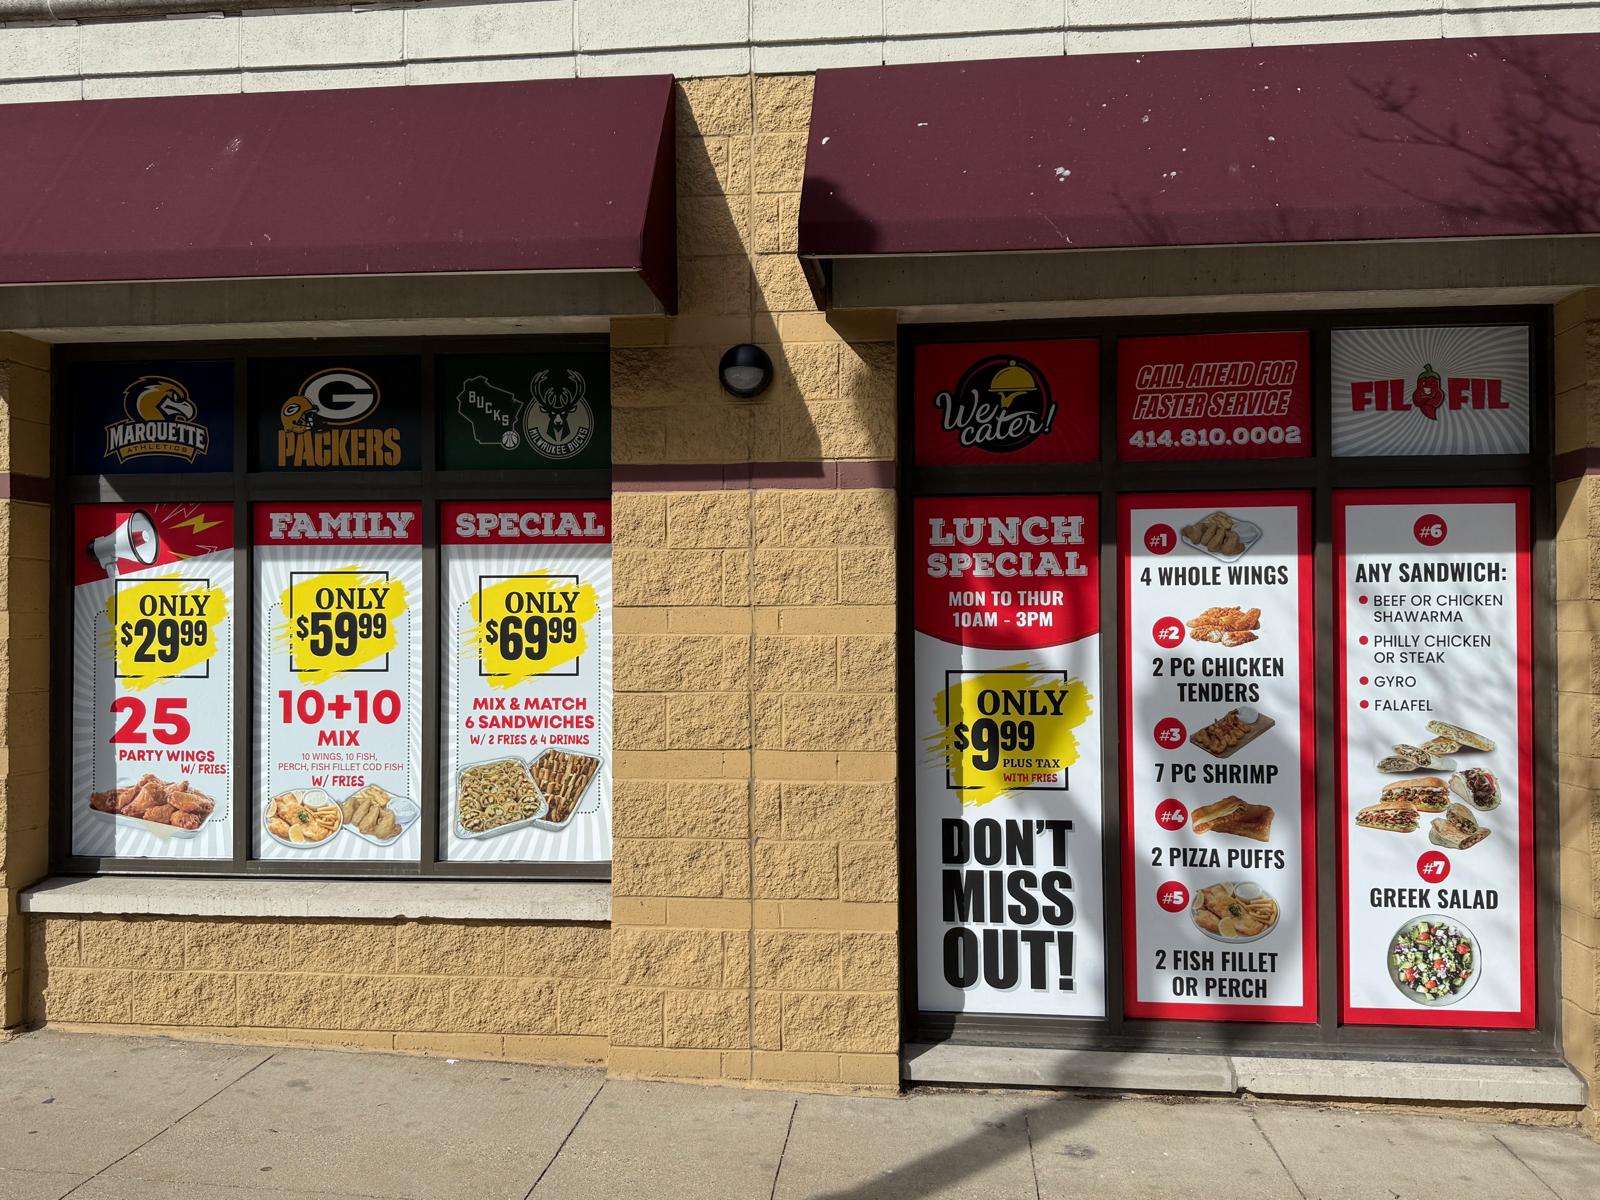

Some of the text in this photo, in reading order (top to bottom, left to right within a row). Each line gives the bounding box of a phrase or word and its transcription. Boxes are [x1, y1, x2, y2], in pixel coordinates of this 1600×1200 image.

[1136, 360, 1297, 390] CALL AHEAD FOR
[1351, 378, 1509, 411] FIL FIL
[469, 391, 509, 426] BUCKS
[936, 389, 999, 430] We
[1133, 390, 1292, 420] FASTER SERVICE
[961, 404, 1056, 445] cater!
[110, 422, 207, 450] MARQUETTE
[528, 428, 588, 455] MILWAUKEE BUCKS
[1129, 426, 1301, 448] 414.810.0002
[127, 443, 187, 453] ATHLETICS
[278, 428, 401, 466] PACKERS
[270, 512, 604, 540] FAMILY SPECIAL
[929, 516, 1084, 546] LUNCH
[1420, 524, 1442, 538] #6
[1150, 533, 1167, 547] #1
[927, 552, 1088, 578] SPECIAL
[1355, 563, 1506, 582] ANY SANDWICH:
[1140, 566, 1288, 586] 4 WHOLE WINGS
[140, 595, 210, 616] ONLY
[316, 588, 390, 609] ONLY
[505, 592, 580, 613] ONLY
[949, 591, 1063, 607] MON TO THUR
[1374, 595, 1503, 606] BEEF OR CHICKEN
[953, 612, 997, 627] 10AM
[1016, 612, 1052, 626] 3PM
[1374, 611, 1463, 622] SHAWARMA
[1158, 626, 1179, 639] #2
[1374, 635, 1491, 648] PHILLY CHICKEN
[1374, 651, 1445, 663] OR STEAK
[1152, 658, 1284, 677] 2 PC CHICKEN
[1374, 676, 1416, 687] GYRO
[1177, 683, 1260, 702] TENDERS
[279, 690, 401, 724] 10+10
[473, 697, 586, 710] MIX & MATCH
[977, 690, 1068, 716] ONLY
[1375, 700, 1433, 711] FALAFEL
[109, 696, 191, 745] 25
[465, 715, 594, 729] 6 SANDWICHES
[318, 730, 360, 746] MIX
[470, 734, 589, 745] W/ 2 FRIES & 4 DRINKS
[1160, 728, 1181, 742] #3
[120, 750, 215, 762] PARTY WINGS
[312, 753, 343, 761] WINGS,
[357, 753, 377, 761] FISH,
[1003, 759, 1060, 768] PLUS TAX
[181, 764, 226, 774] W/ FRIES
[278, 763, 308, 771] PERCH,
[1155, 763, 1278, 784] 7 PC SHRIMP
[312, 775, 365, 787] W/ FRIES
[1003, 773, 1057, 783] WITH FRIES
[1161, 810, 1184, 823] #4
[942, 818, 1074, 867] DON'T
[1151, 847, 1285, 869] 2 PIZZA PUFFS
[1423, 861, 1445, 875] #7
[942, 870, 1075, 926] MISS
[1163, 891, 1183, 905] #5
[1370, 888, 1498, 909] GREEK SALAD
[943, 927, 1075, 991] OUT!
[1156, 950, 1278, 973] 2 FISH FILLET
[1173, 977, 1267, 999] OR PERCH
